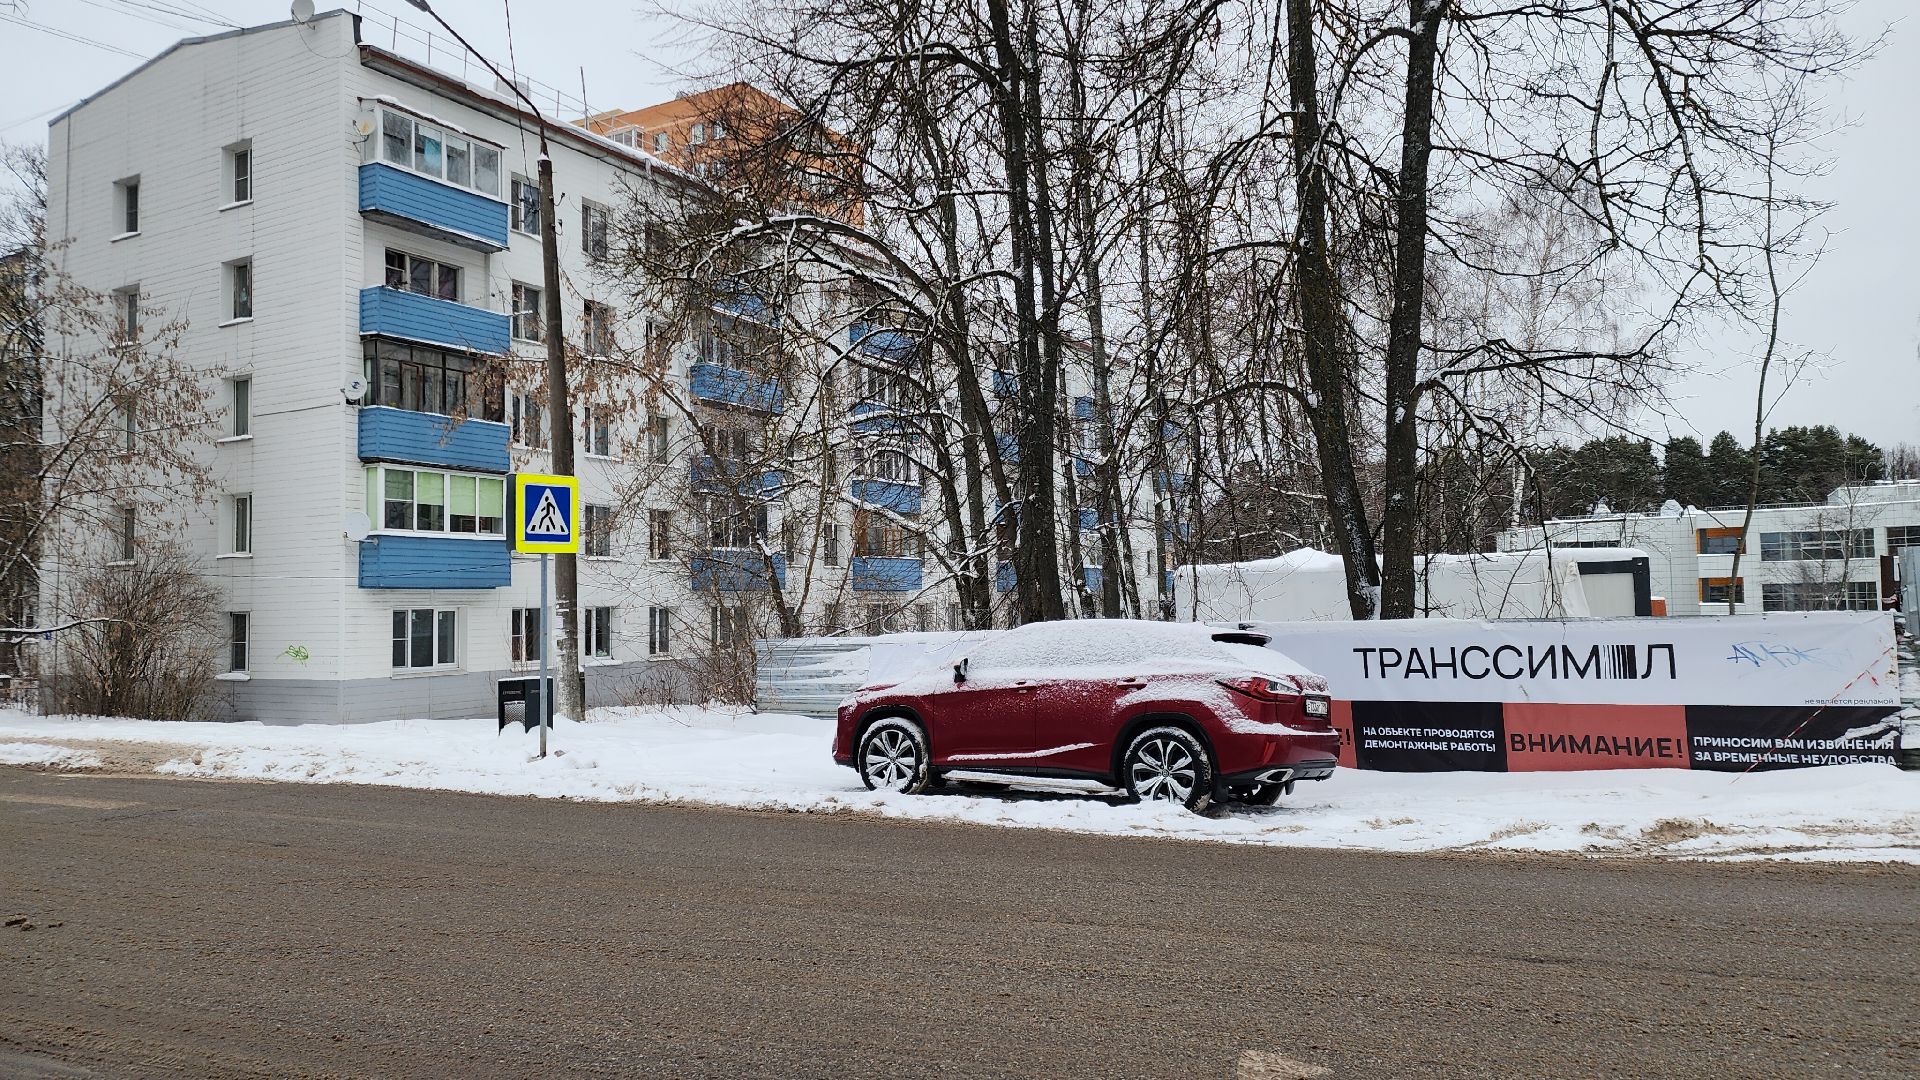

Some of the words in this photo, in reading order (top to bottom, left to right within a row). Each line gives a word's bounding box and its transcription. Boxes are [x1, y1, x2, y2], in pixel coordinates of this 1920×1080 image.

[1363, 726, 1377, 736] НА
[1378, 727, 1422, 737] ОБЪЕКТЕ
[1423, 728, 1495, 739] ПРОВОДЯТСЯ
[1364, 739, 1448, 751] ДЕМОНТАЖНЫЕ
[1450, 742, 1496, 752] РАБОТЫ
[1510, 733, 1683, 758] ВНИМАНИЕ!
[1694, 736, 1773, 749] ПРИНОСИМ
[1775, 738, 1804, 749] ВАМ
[1806, 739, 1894, 750] ИЗВИНЕНИЯ
[1695, 751, 1711, 761] ЗА
[1714, 752, 1799, 764] ВРЕМЕННЫЕ
[1802, 753, 1896, 766] НЕУДОБСТВА
